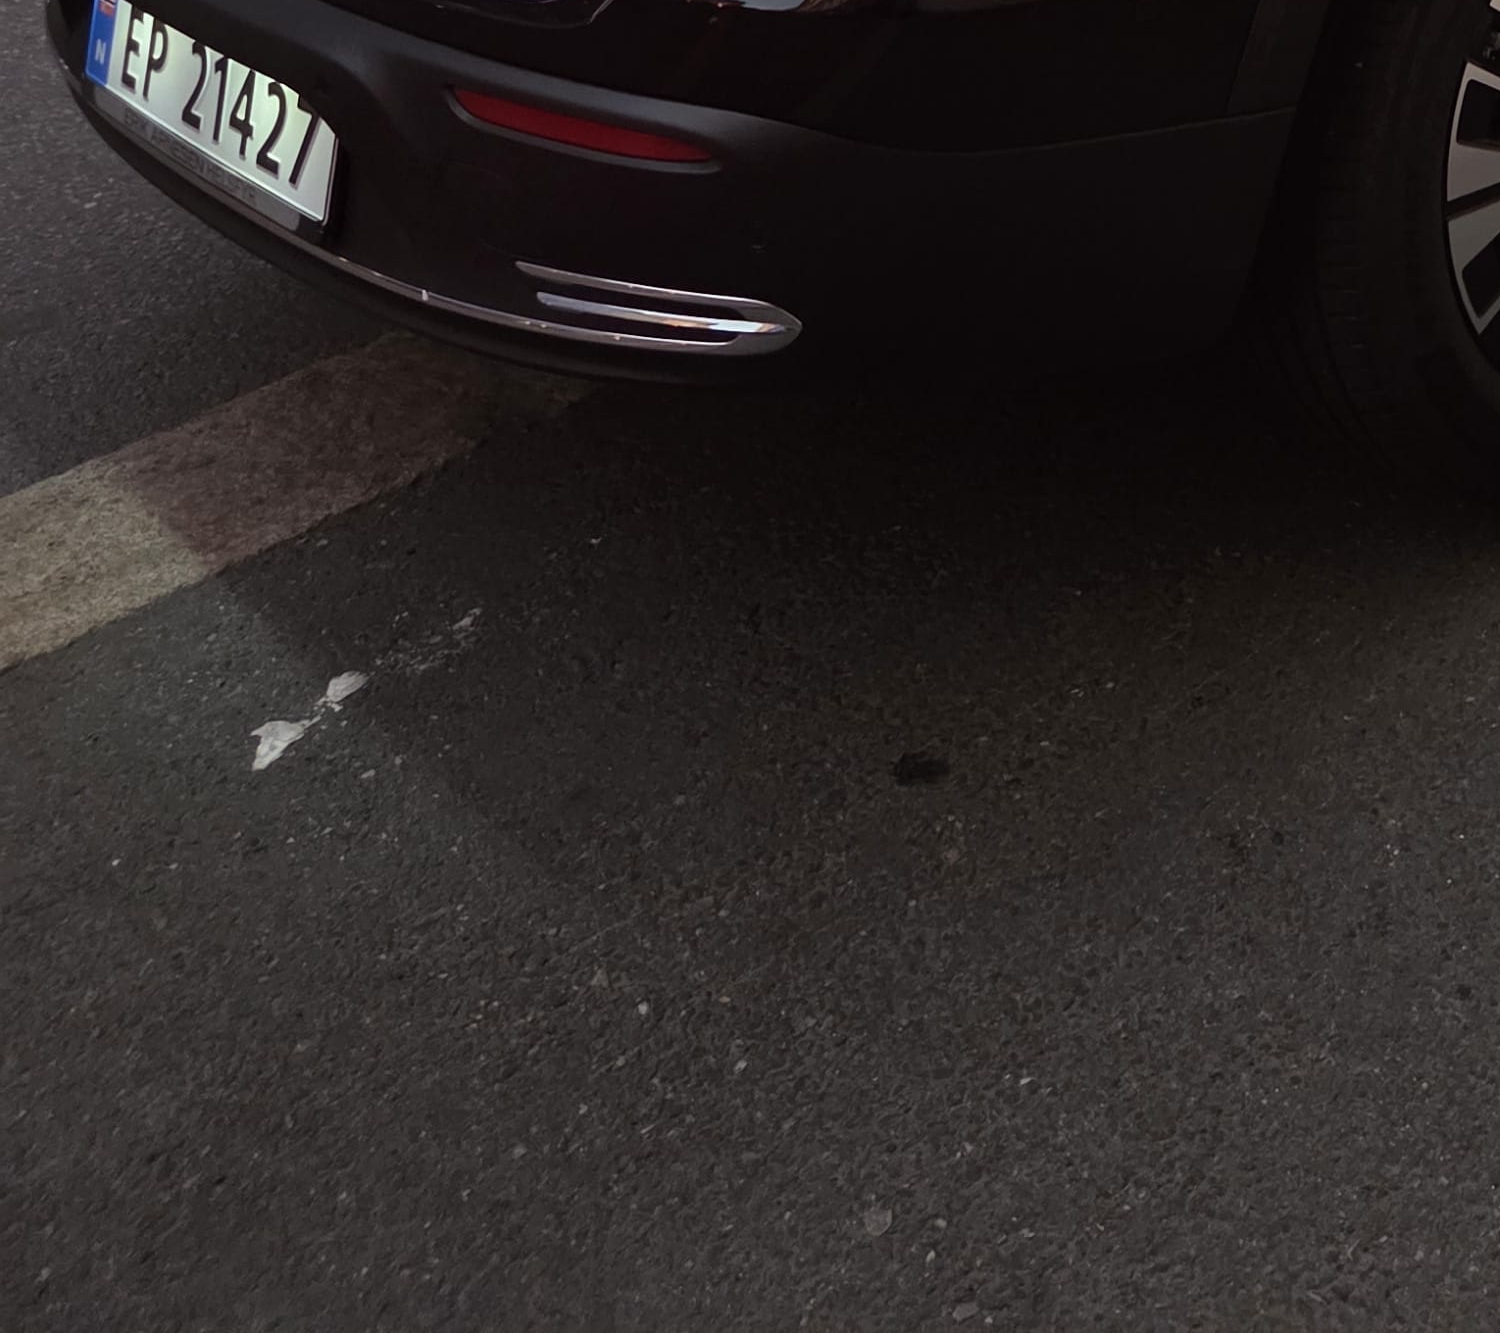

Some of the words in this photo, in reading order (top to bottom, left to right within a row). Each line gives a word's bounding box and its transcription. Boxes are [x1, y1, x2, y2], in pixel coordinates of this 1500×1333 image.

[94, 37, 108, 66] N
[121, 4, 169, 102] EP
[181, 40, 321, 190] 21427
